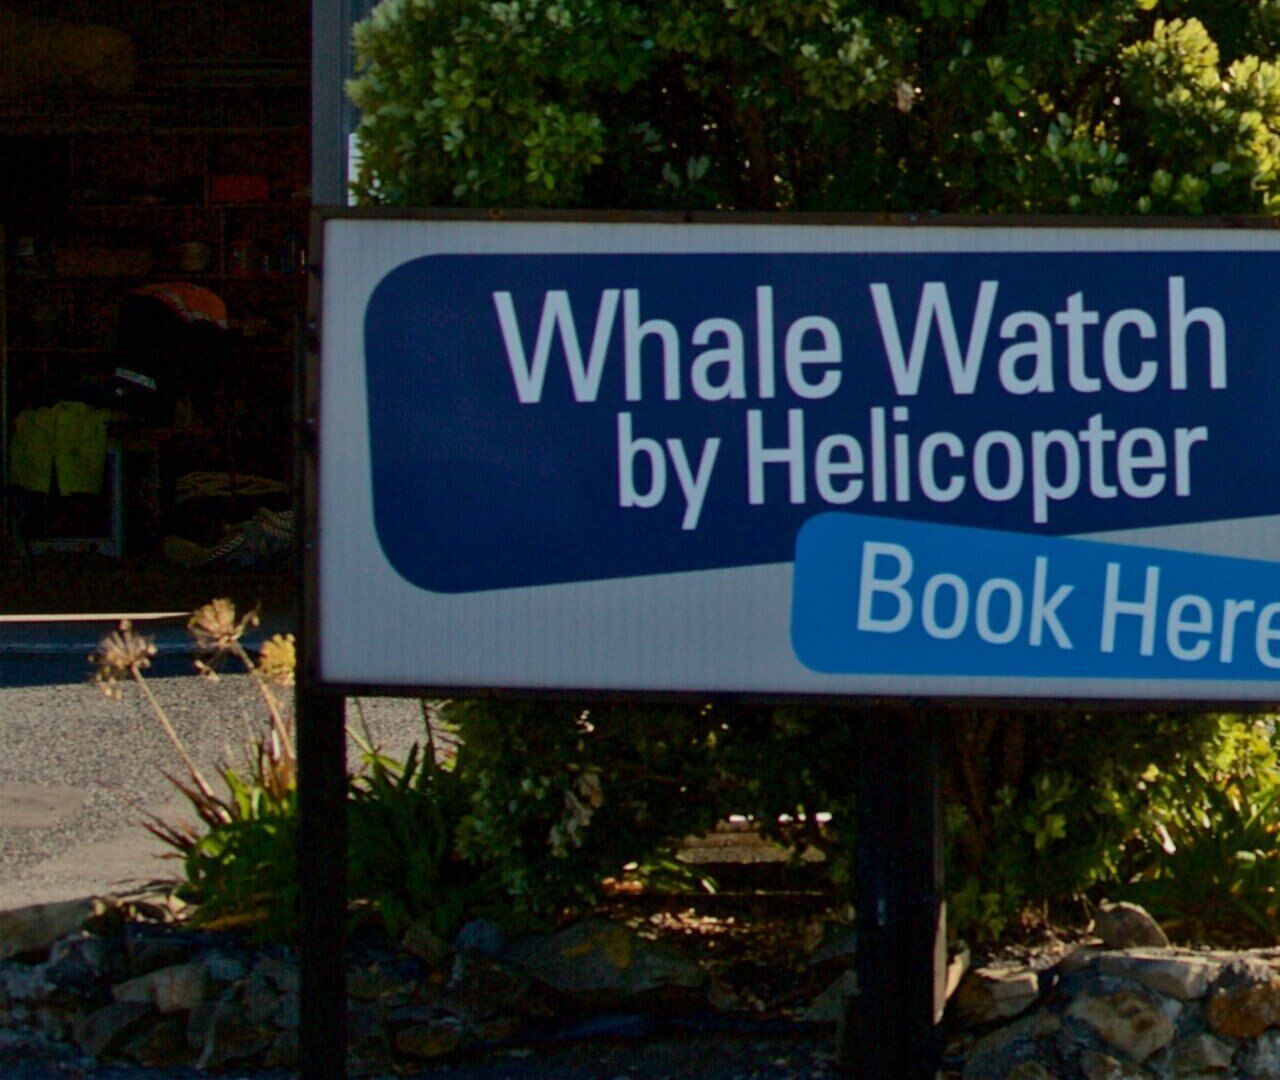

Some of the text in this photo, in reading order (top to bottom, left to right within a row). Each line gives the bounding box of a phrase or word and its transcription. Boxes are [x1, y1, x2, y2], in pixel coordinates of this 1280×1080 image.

[492, 276, 1227, 404] Whale Watch
[617, 406, 1208, 530] by Helicopter
[857, 541, 1074, 650] Book
